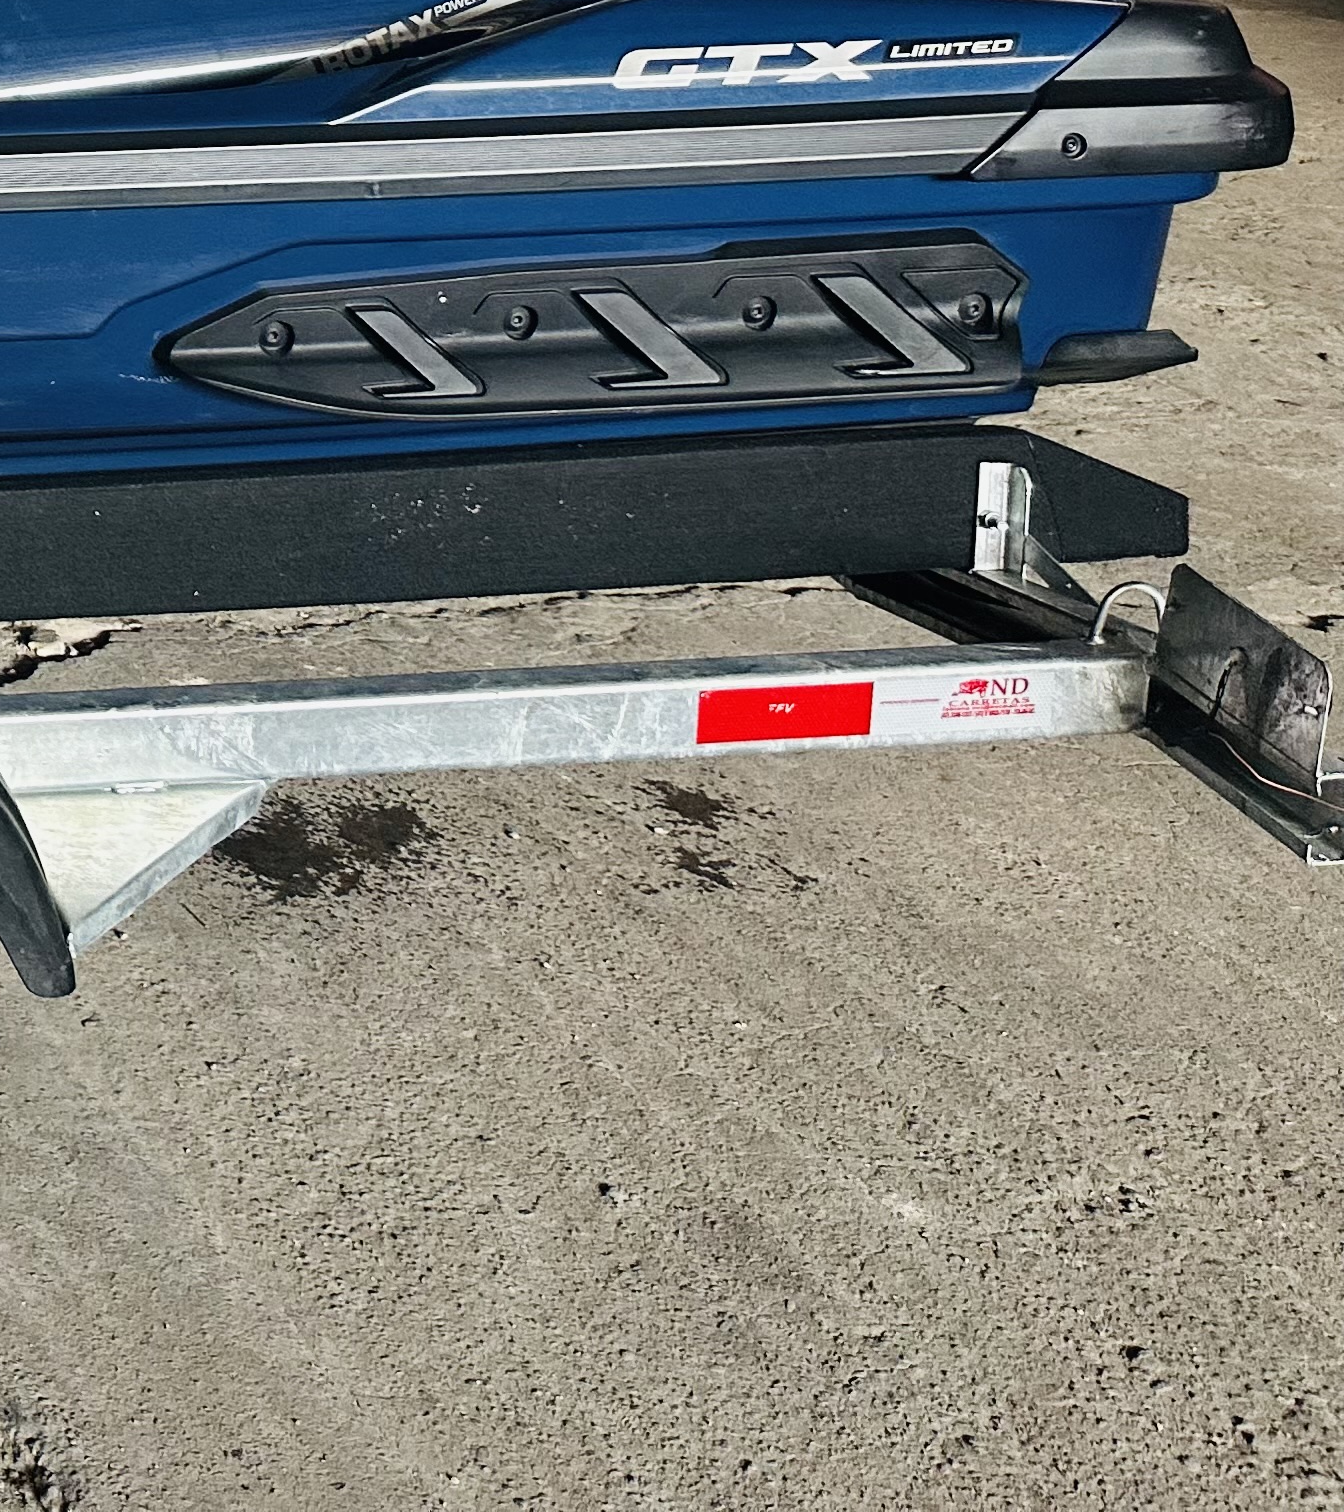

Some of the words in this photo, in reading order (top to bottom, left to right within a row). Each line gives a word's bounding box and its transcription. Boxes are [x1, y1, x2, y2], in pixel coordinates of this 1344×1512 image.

[320, 7, 444, 75] ROTAX
[612, 38, 885, 90] GTX
[889, 37, 1015, 60] LIMITED
